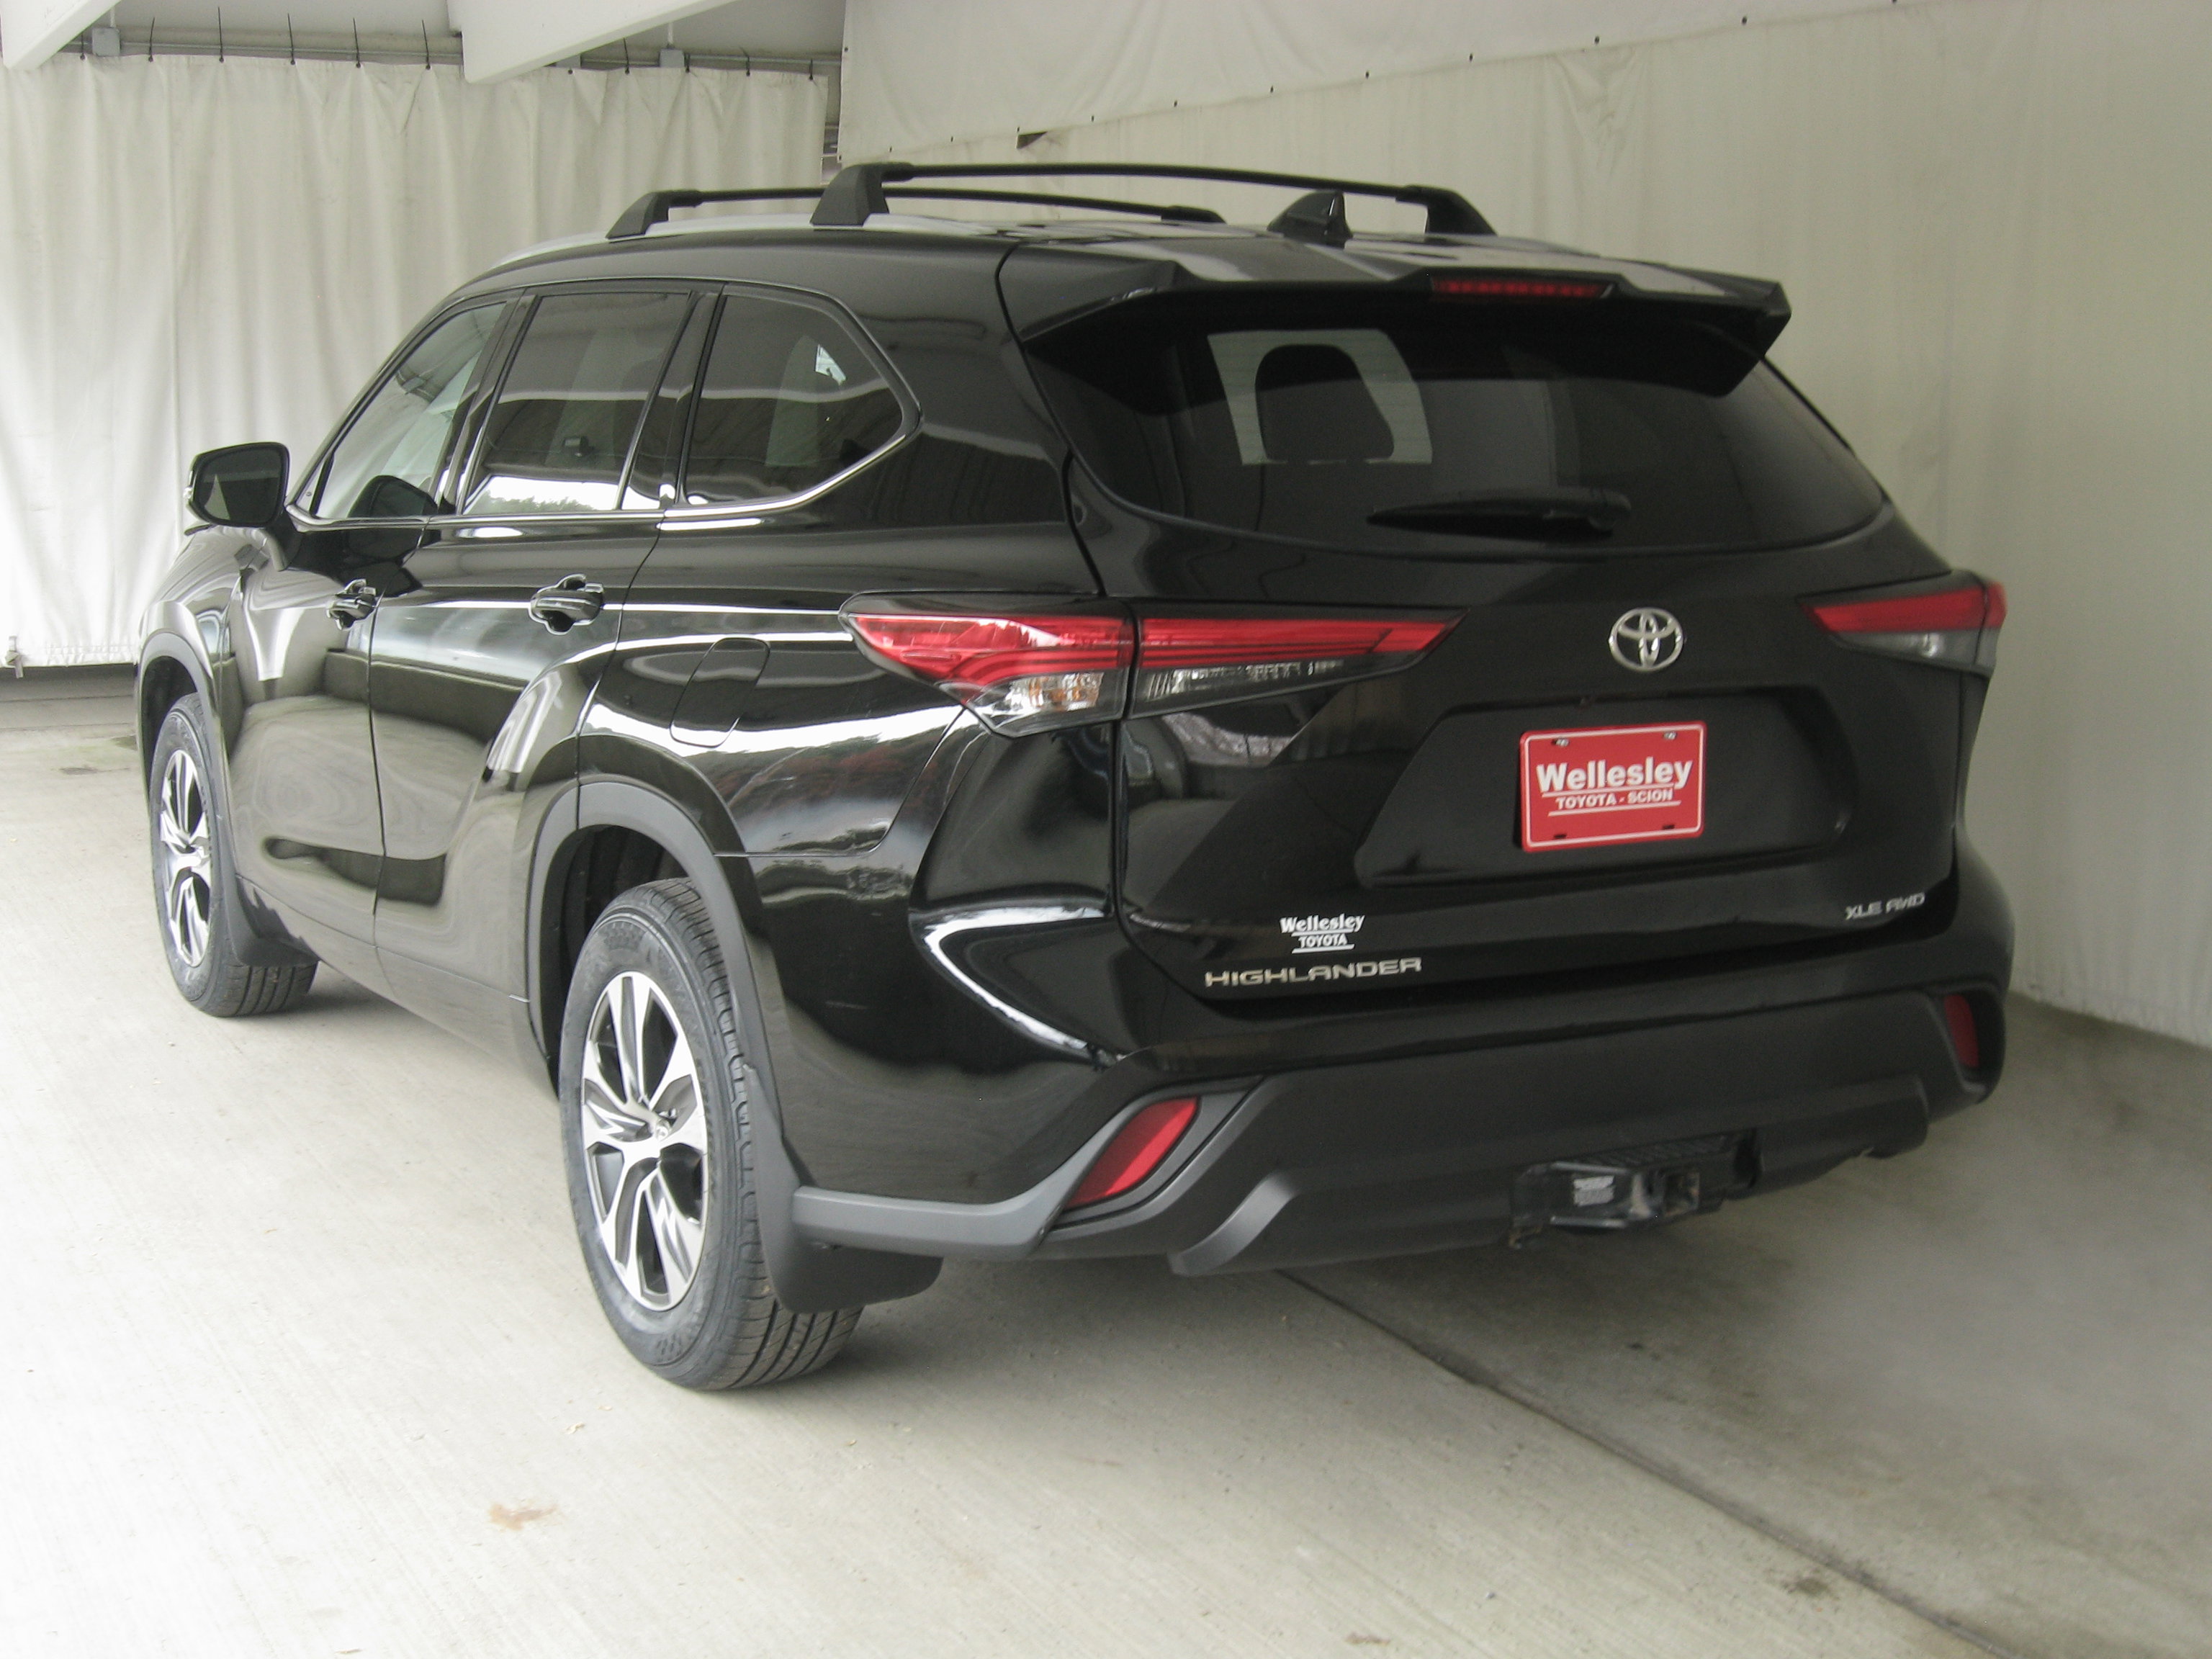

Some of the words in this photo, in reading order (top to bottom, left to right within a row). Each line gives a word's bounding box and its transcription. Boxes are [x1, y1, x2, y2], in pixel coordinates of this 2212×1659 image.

[1536, 757, 1692, 792] Wellesley
[1556, 793, 1617, 810] TOYOTA
[1627, 788, 1673, 804] SCION
[1845, 900, 1882, 920] XLE
[1886, 892, 1925, 913] AWD
[1280, 914, 1365, 933] Wellesley
[1298, 934, 1348, 948] TOYOTA
[1205, 957, 1422, 987] HIGHLANDER
